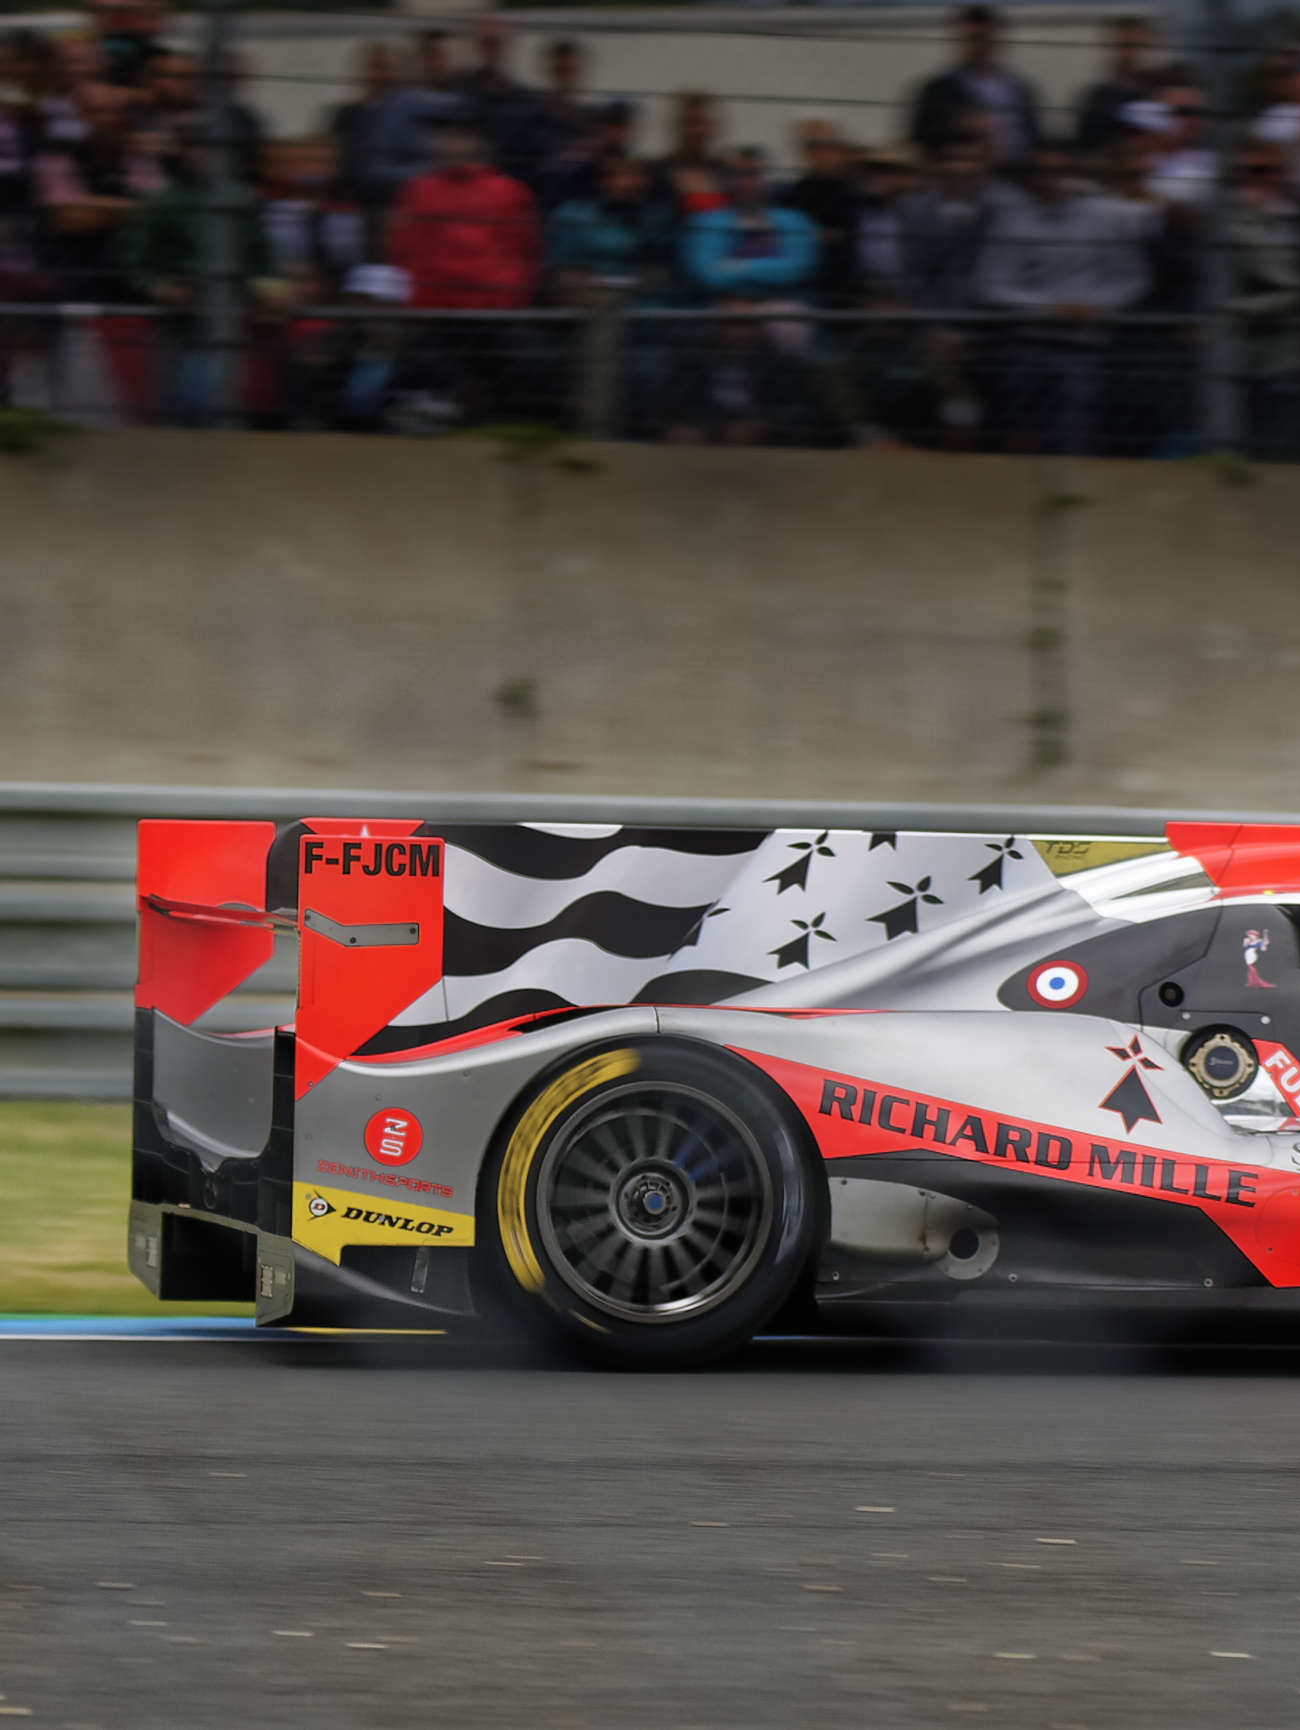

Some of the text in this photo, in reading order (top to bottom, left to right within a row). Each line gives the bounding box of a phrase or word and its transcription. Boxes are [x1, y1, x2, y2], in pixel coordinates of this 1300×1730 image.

[304, 842, 440, 877] F-FJCM
[818, 1079, 1258, 1208] RICHARD MILLE
[316, 1159, 454, 1199] ZENITHSPORTS
[341, 1207, 454, 1237] DUNLOP
